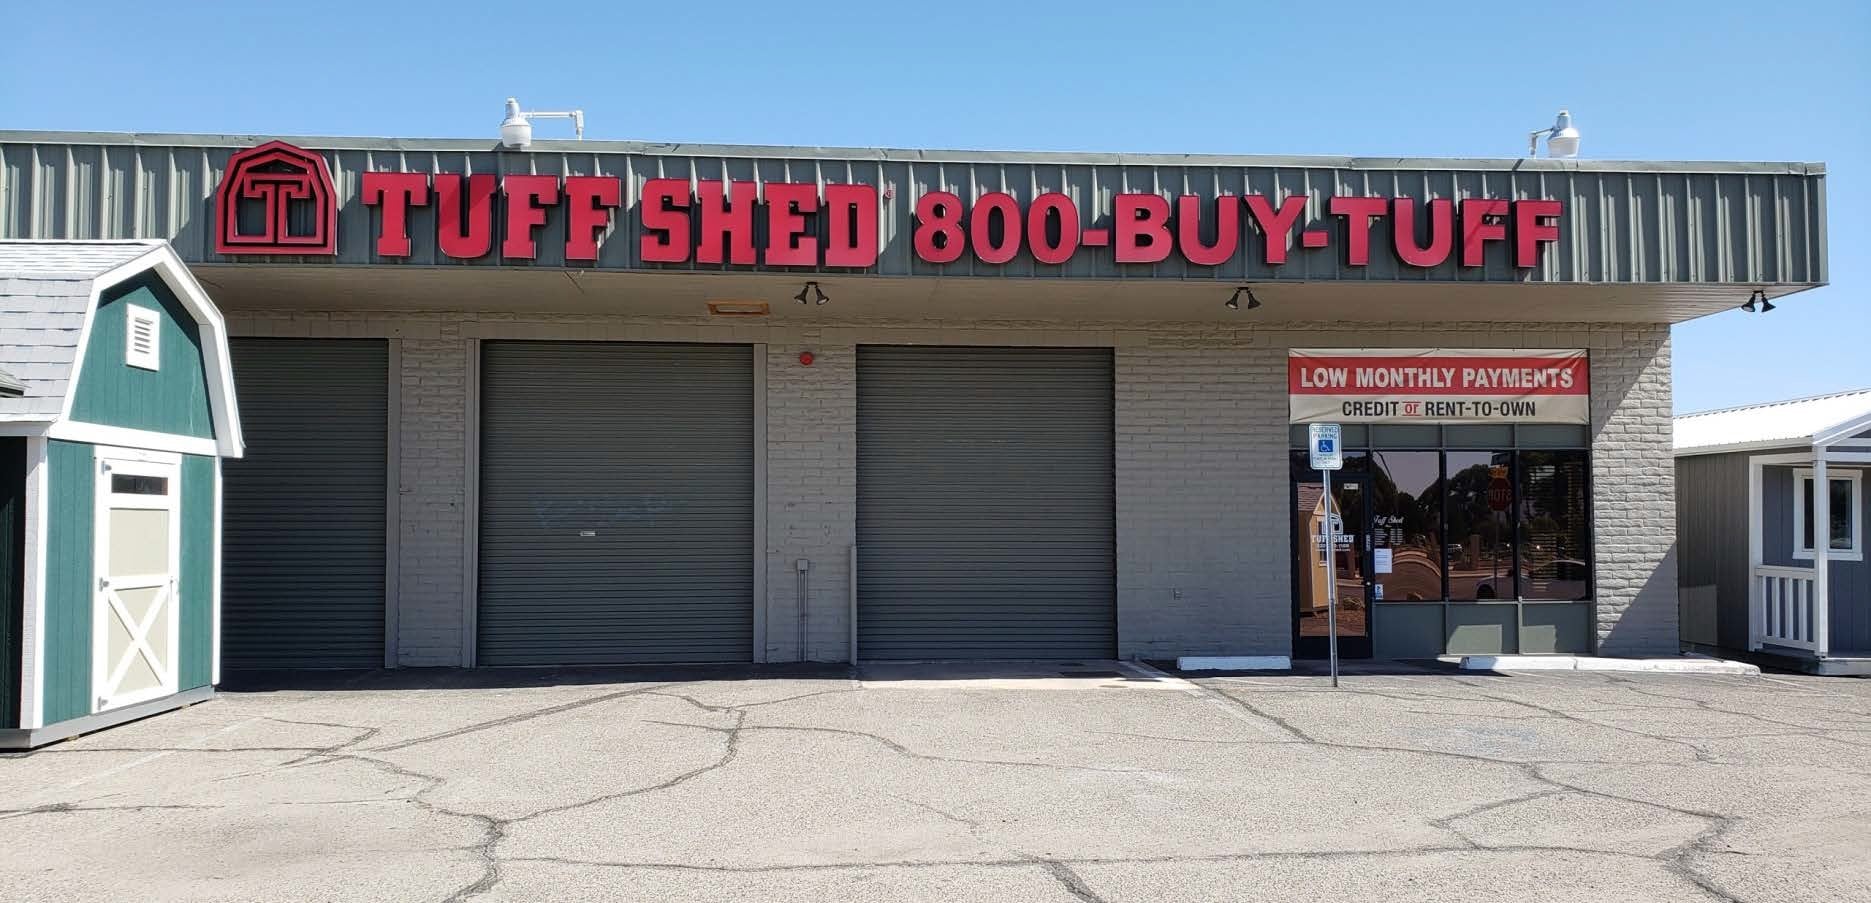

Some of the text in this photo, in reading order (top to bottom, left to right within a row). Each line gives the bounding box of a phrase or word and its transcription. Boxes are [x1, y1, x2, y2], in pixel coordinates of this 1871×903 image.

[362, 171, 878, 267] TUFF SHED
[914, 192, 1563, 268] 800-BUY-TUFF
[1301, 367, 1574, 388] LOW MONTHLY PAYMENTS
[1342, 401, 1536, 417] CREDIT or RENT-TO-OWN
[1311, 534, 1354, 543] TUF SHED
